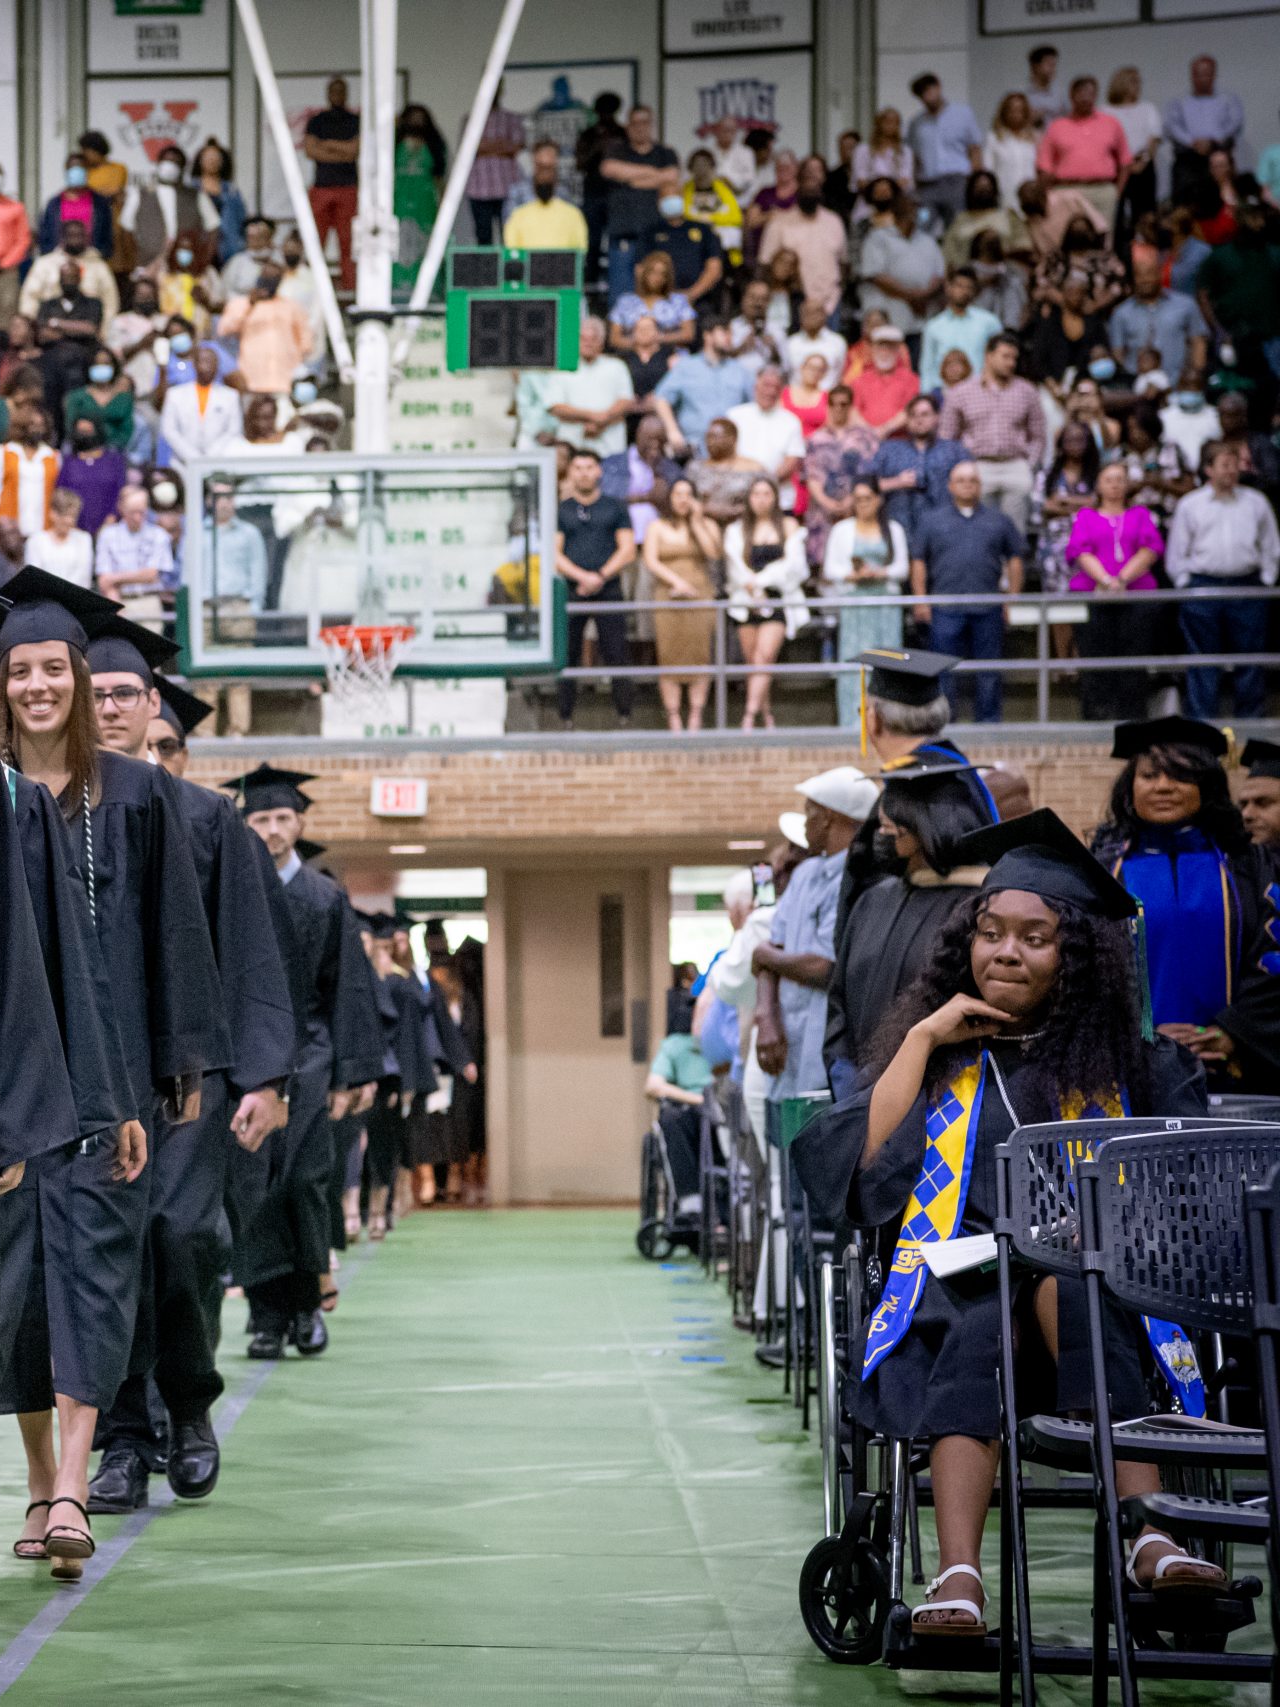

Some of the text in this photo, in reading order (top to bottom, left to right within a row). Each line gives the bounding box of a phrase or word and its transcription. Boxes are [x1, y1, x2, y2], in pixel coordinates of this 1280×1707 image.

[136, 24, 179, 40] DELTA
[692, 16, 783, 37] UNIVERSITY
[136, 44, 179, 60] STATE
[380, 781, 418, 811] EXIT
